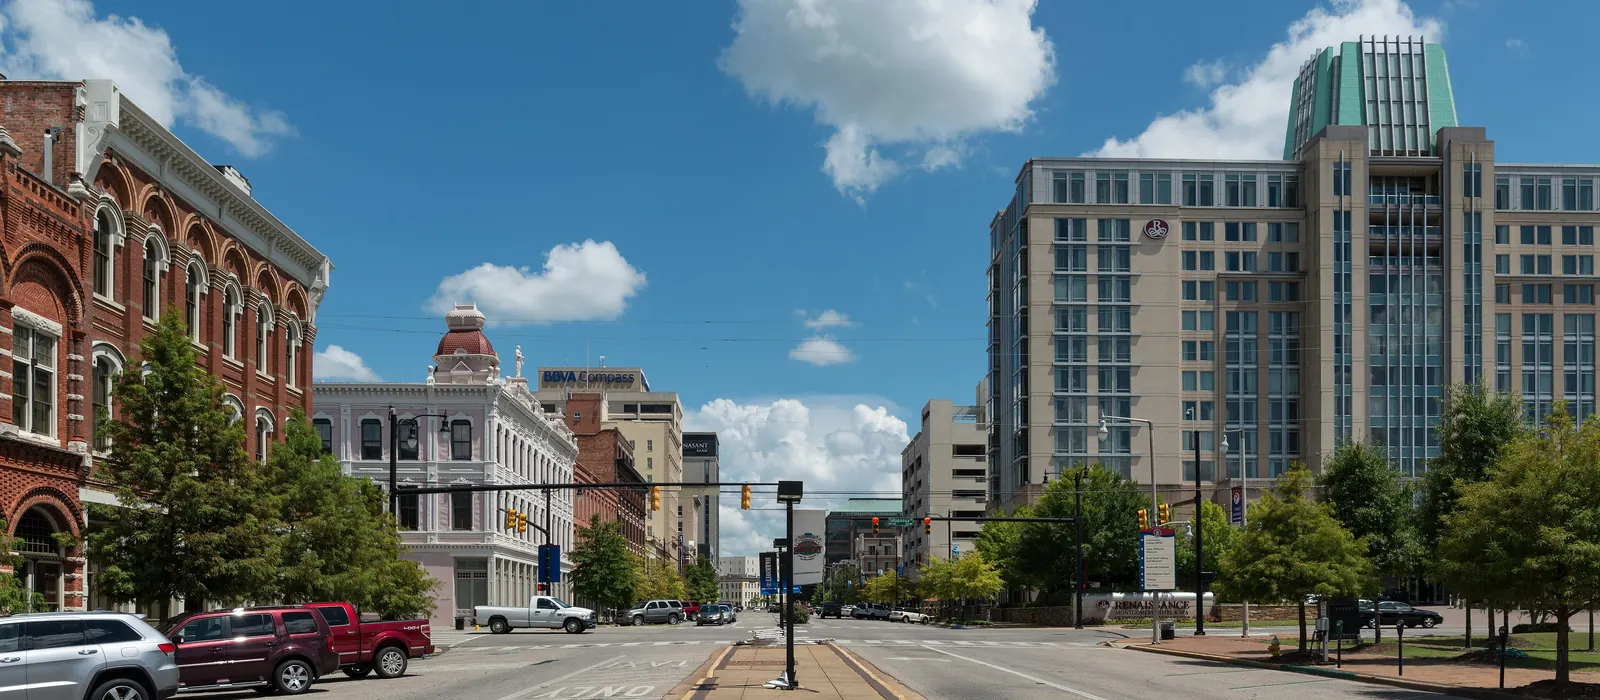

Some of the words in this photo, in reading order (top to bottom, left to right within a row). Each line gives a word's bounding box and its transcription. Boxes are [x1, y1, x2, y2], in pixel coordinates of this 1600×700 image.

[543, 371, 577, 382] BBVA
[579, 371, 635, 384] Compass
[532, 685, 656, 698] ONLY
